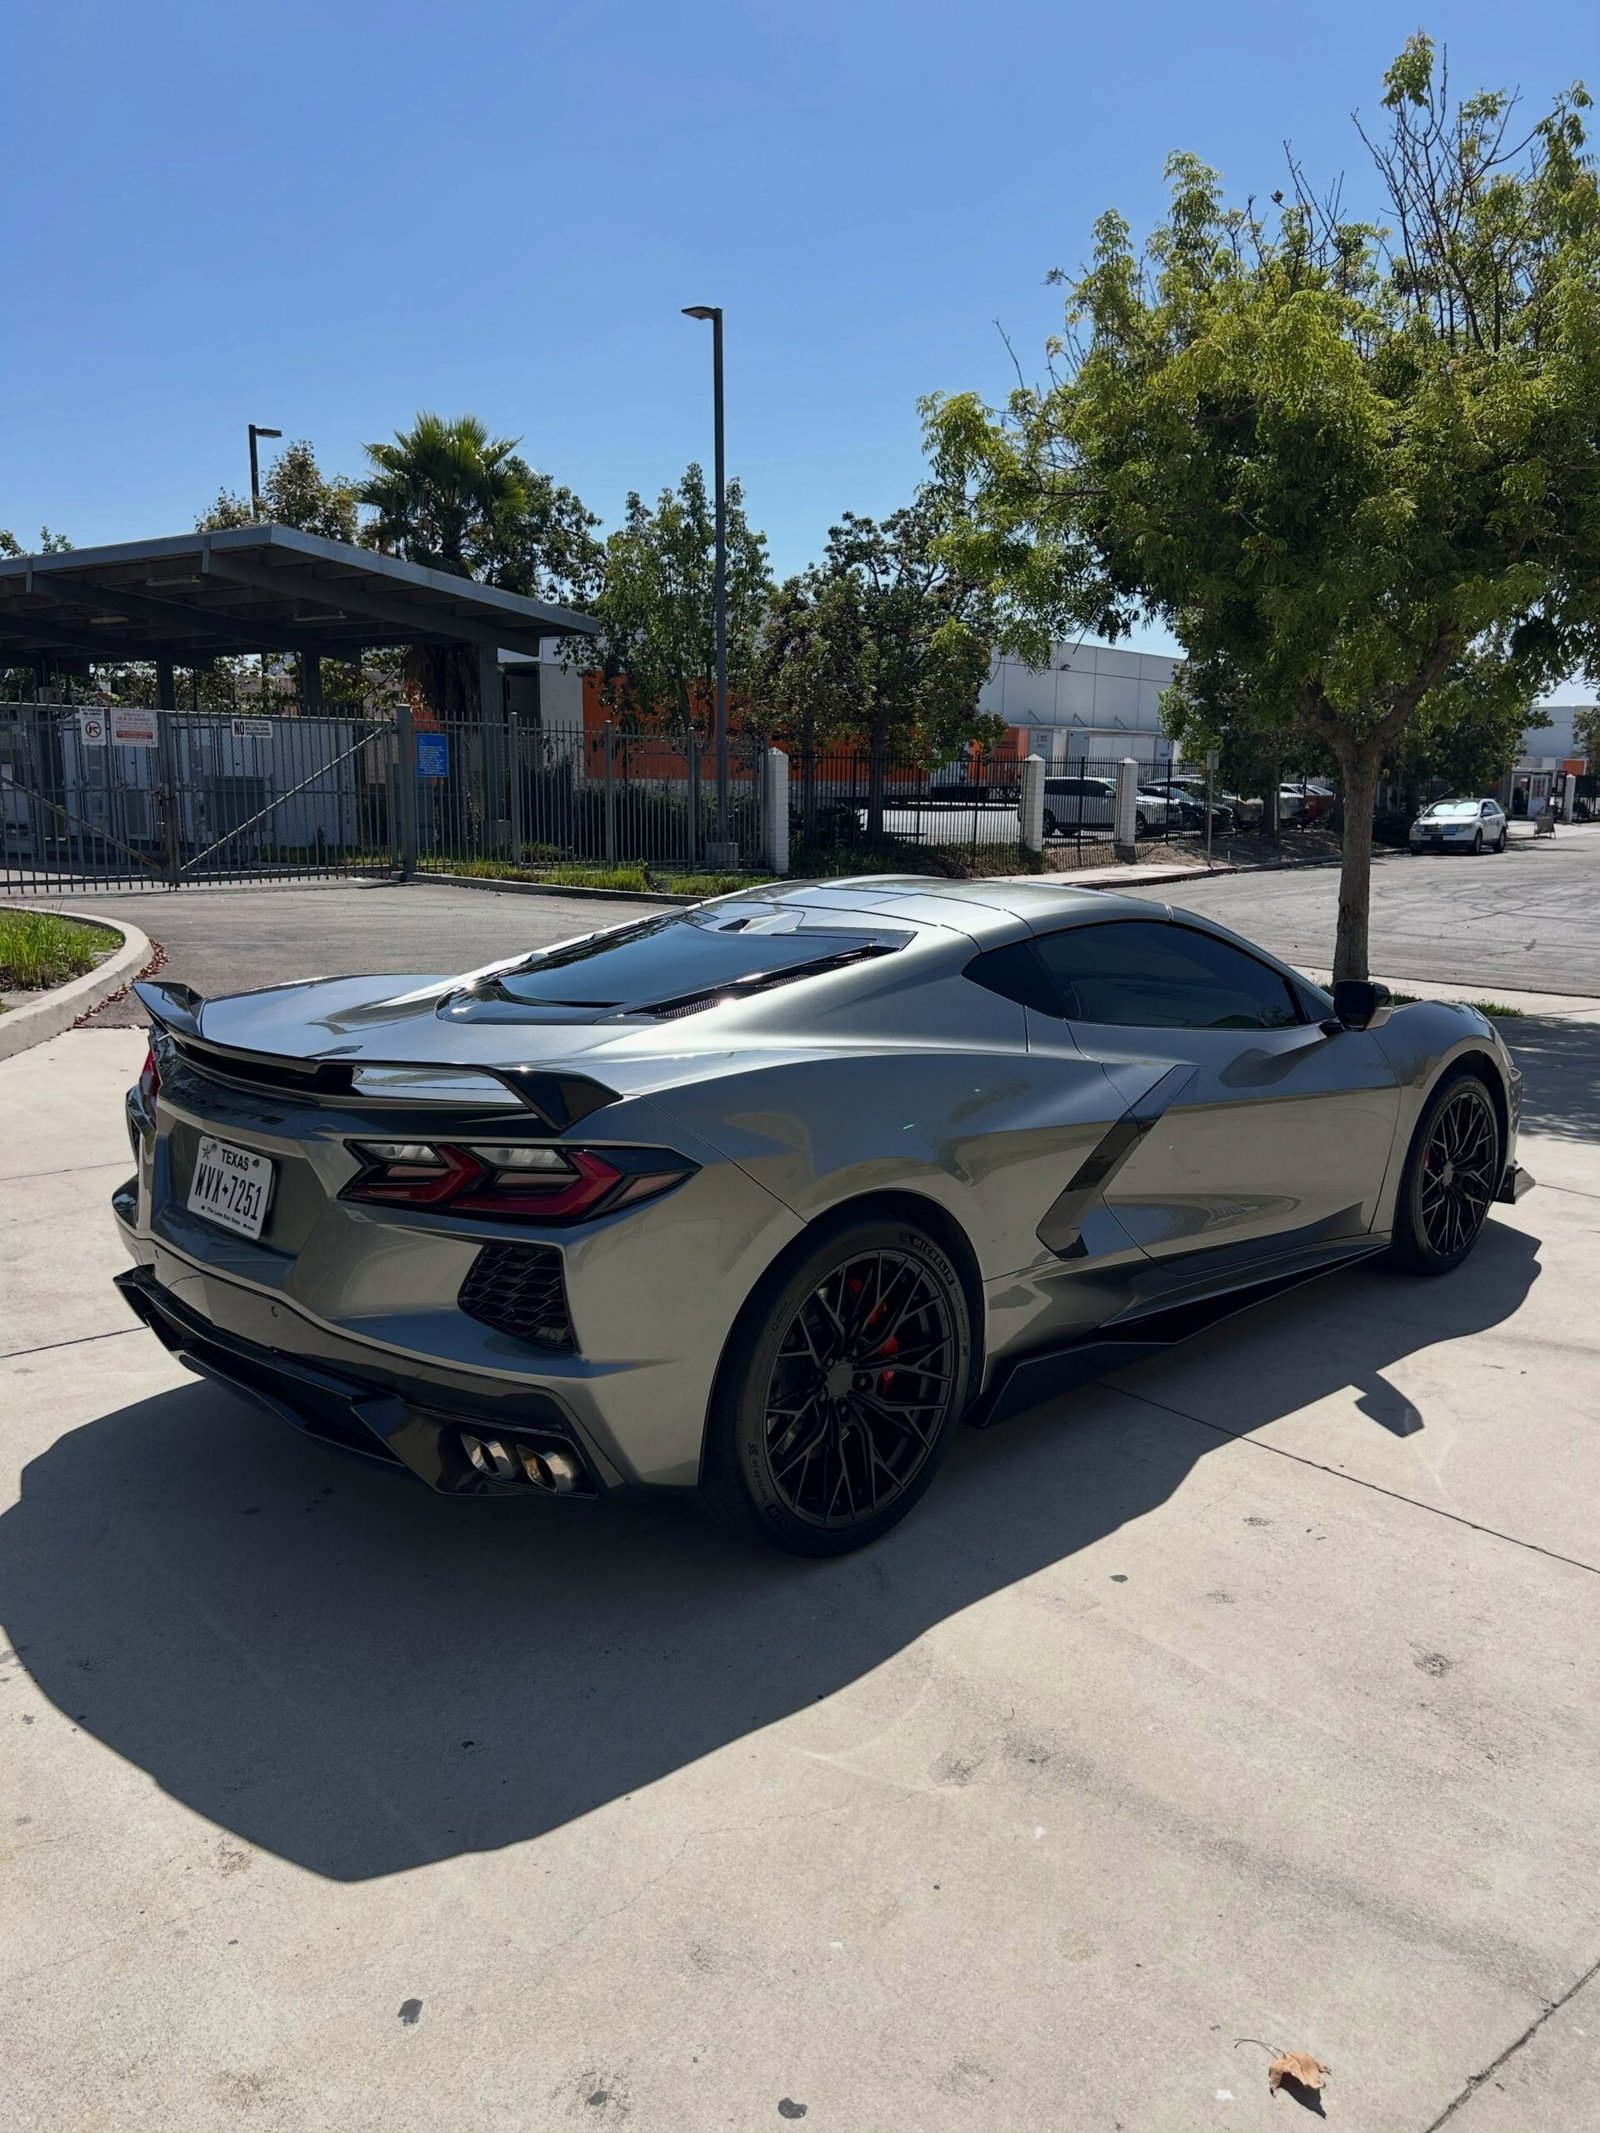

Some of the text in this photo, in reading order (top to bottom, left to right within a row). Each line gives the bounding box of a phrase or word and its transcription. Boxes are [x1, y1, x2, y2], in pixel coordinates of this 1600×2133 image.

[234, 720, 245, 736] NO
[221, 1149, 250, 1172] TEXAS
[227, 1175, 262, 1222] 7251
[912, 1238, 954, 1284] MICHELIN
